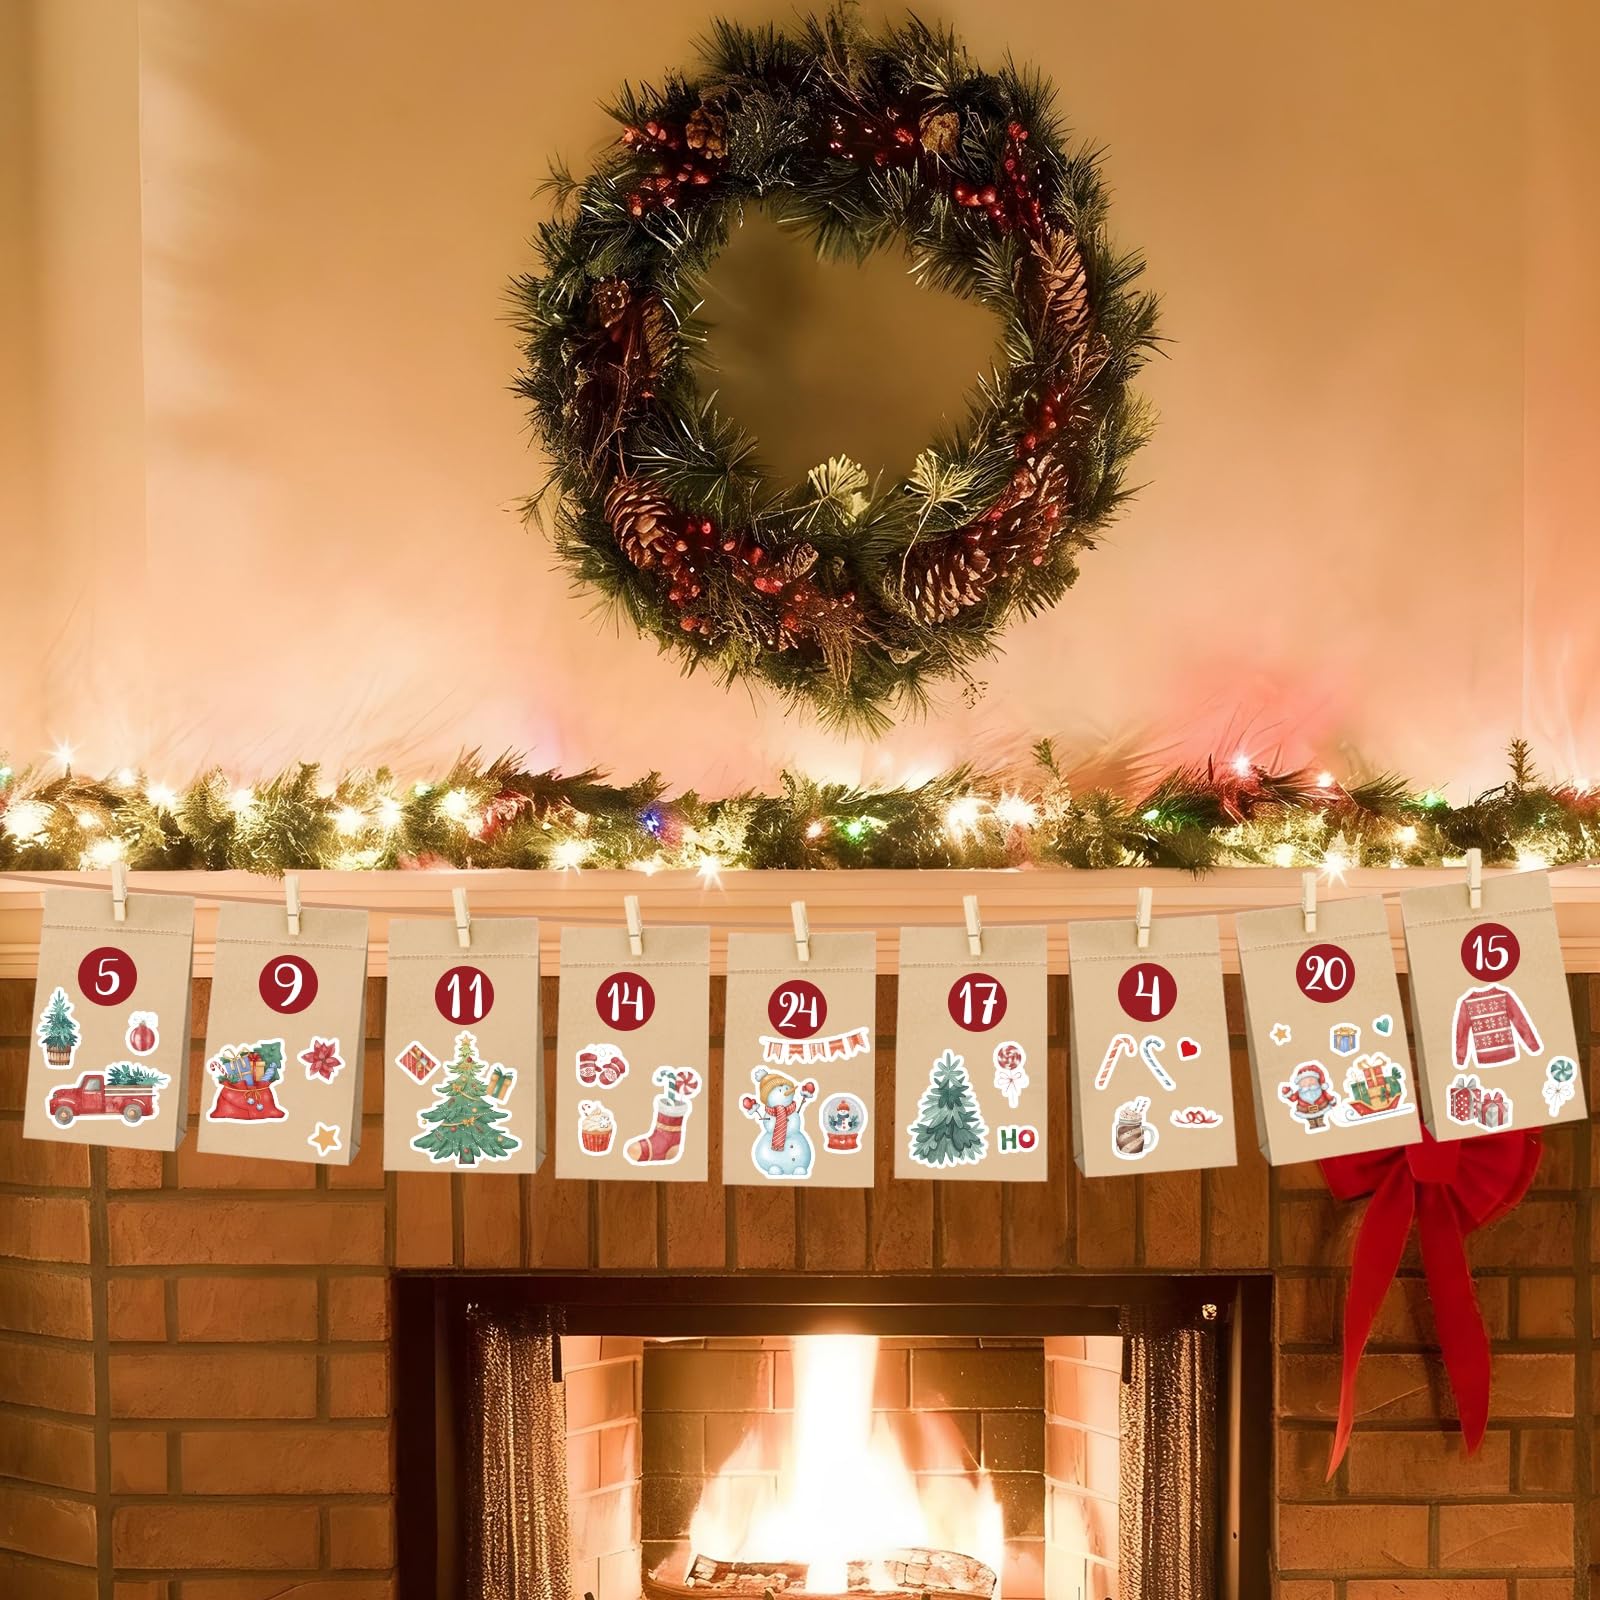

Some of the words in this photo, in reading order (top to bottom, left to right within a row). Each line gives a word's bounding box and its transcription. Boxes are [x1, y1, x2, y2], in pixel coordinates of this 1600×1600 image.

[1472, 935, 1509, 971] 15
[95, 958, 120, 996] 5
[274, 962, 303, 1007] 9
[1305, 955, 1347, 991] 20
[447, 973, 483, 1019] 11
[607, 981, 644, 1021] 14
[778, 991, 818, 1028] 24
[959, 981, 998, 1025] 17
[1135, 970, 1161, 1016] 4
[1000, 1128, 1035, 1151] HO
